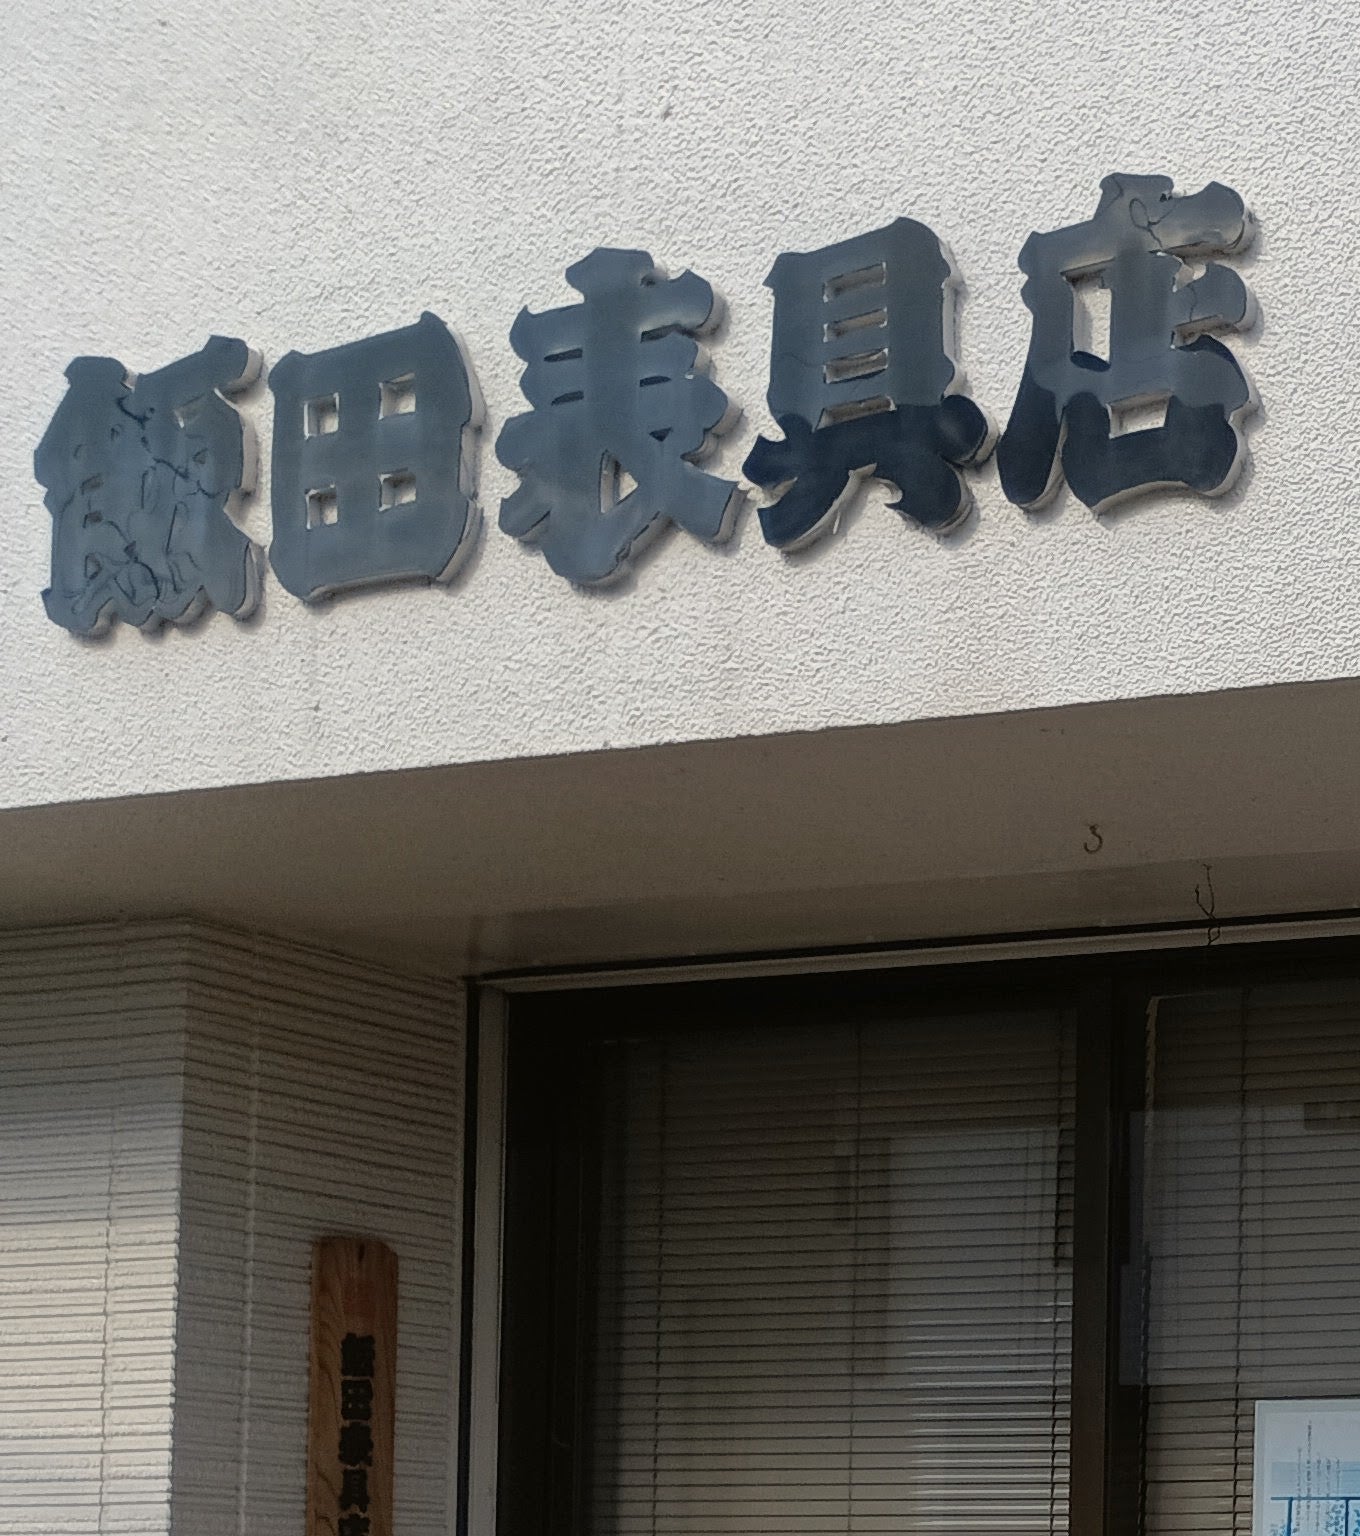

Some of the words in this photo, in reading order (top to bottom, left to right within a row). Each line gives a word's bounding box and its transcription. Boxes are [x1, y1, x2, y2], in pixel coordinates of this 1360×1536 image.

[33, 170, 1258, 638] 飯田表具店
